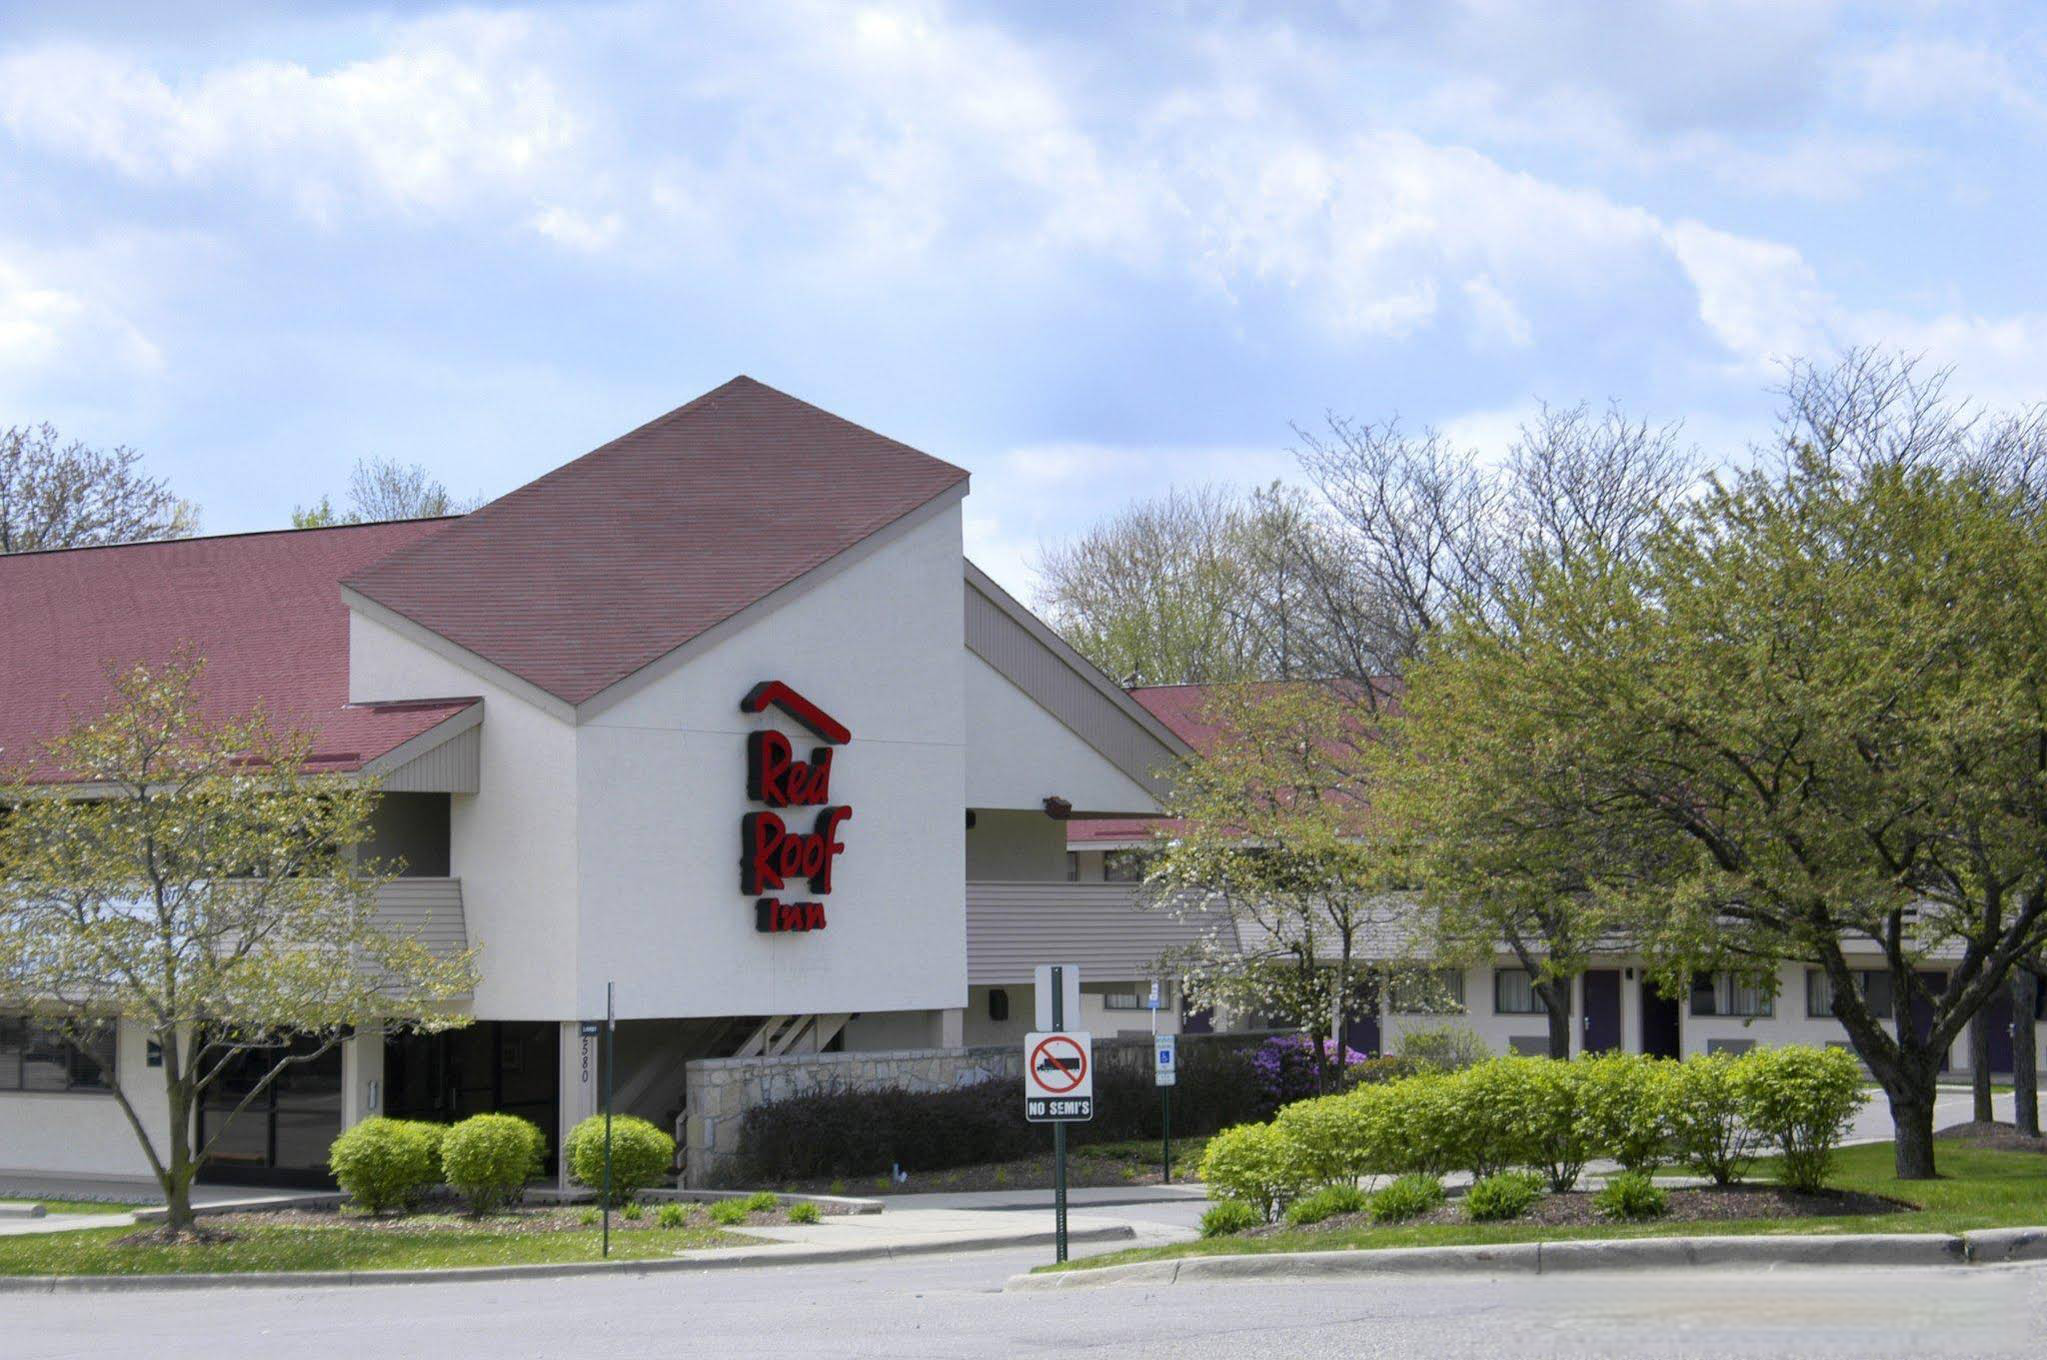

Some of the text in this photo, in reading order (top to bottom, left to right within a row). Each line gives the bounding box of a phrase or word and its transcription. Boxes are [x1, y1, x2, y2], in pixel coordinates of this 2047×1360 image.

[749, 730, 833, 808] Red
[742, 806, 852, 895] Roof
[757, 898, 826, 932] Inn
[1029, 1101, 1090, 1115] NO SEMI'S
